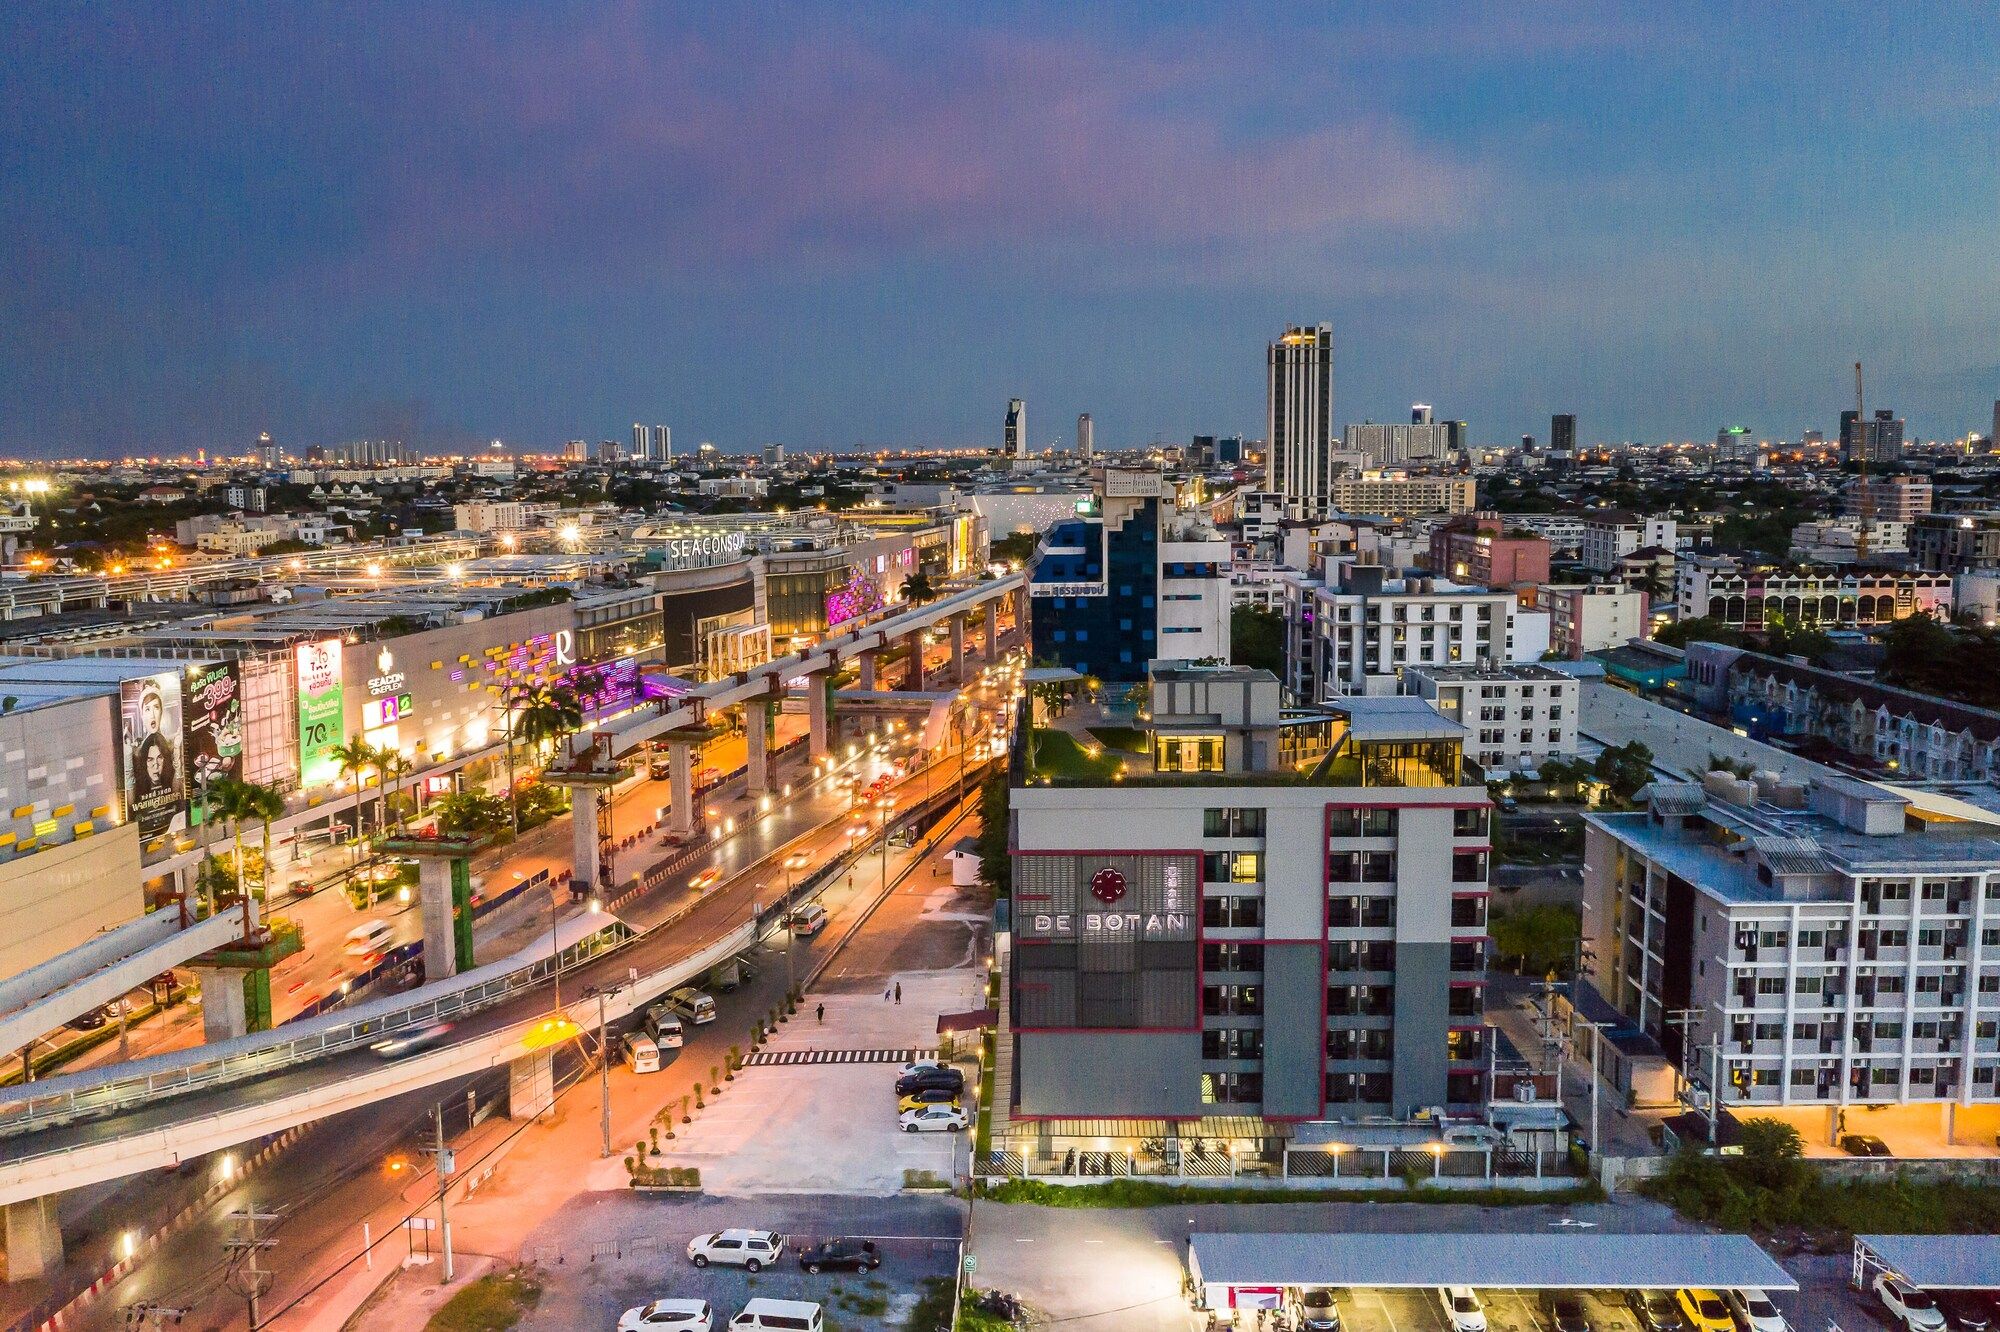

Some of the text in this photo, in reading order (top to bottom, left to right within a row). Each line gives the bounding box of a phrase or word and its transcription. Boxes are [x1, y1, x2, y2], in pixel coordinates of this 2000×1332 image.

[367, 673, 405, 690] SEACON
[1035, 914, 1184, 931] DE BOTAN
